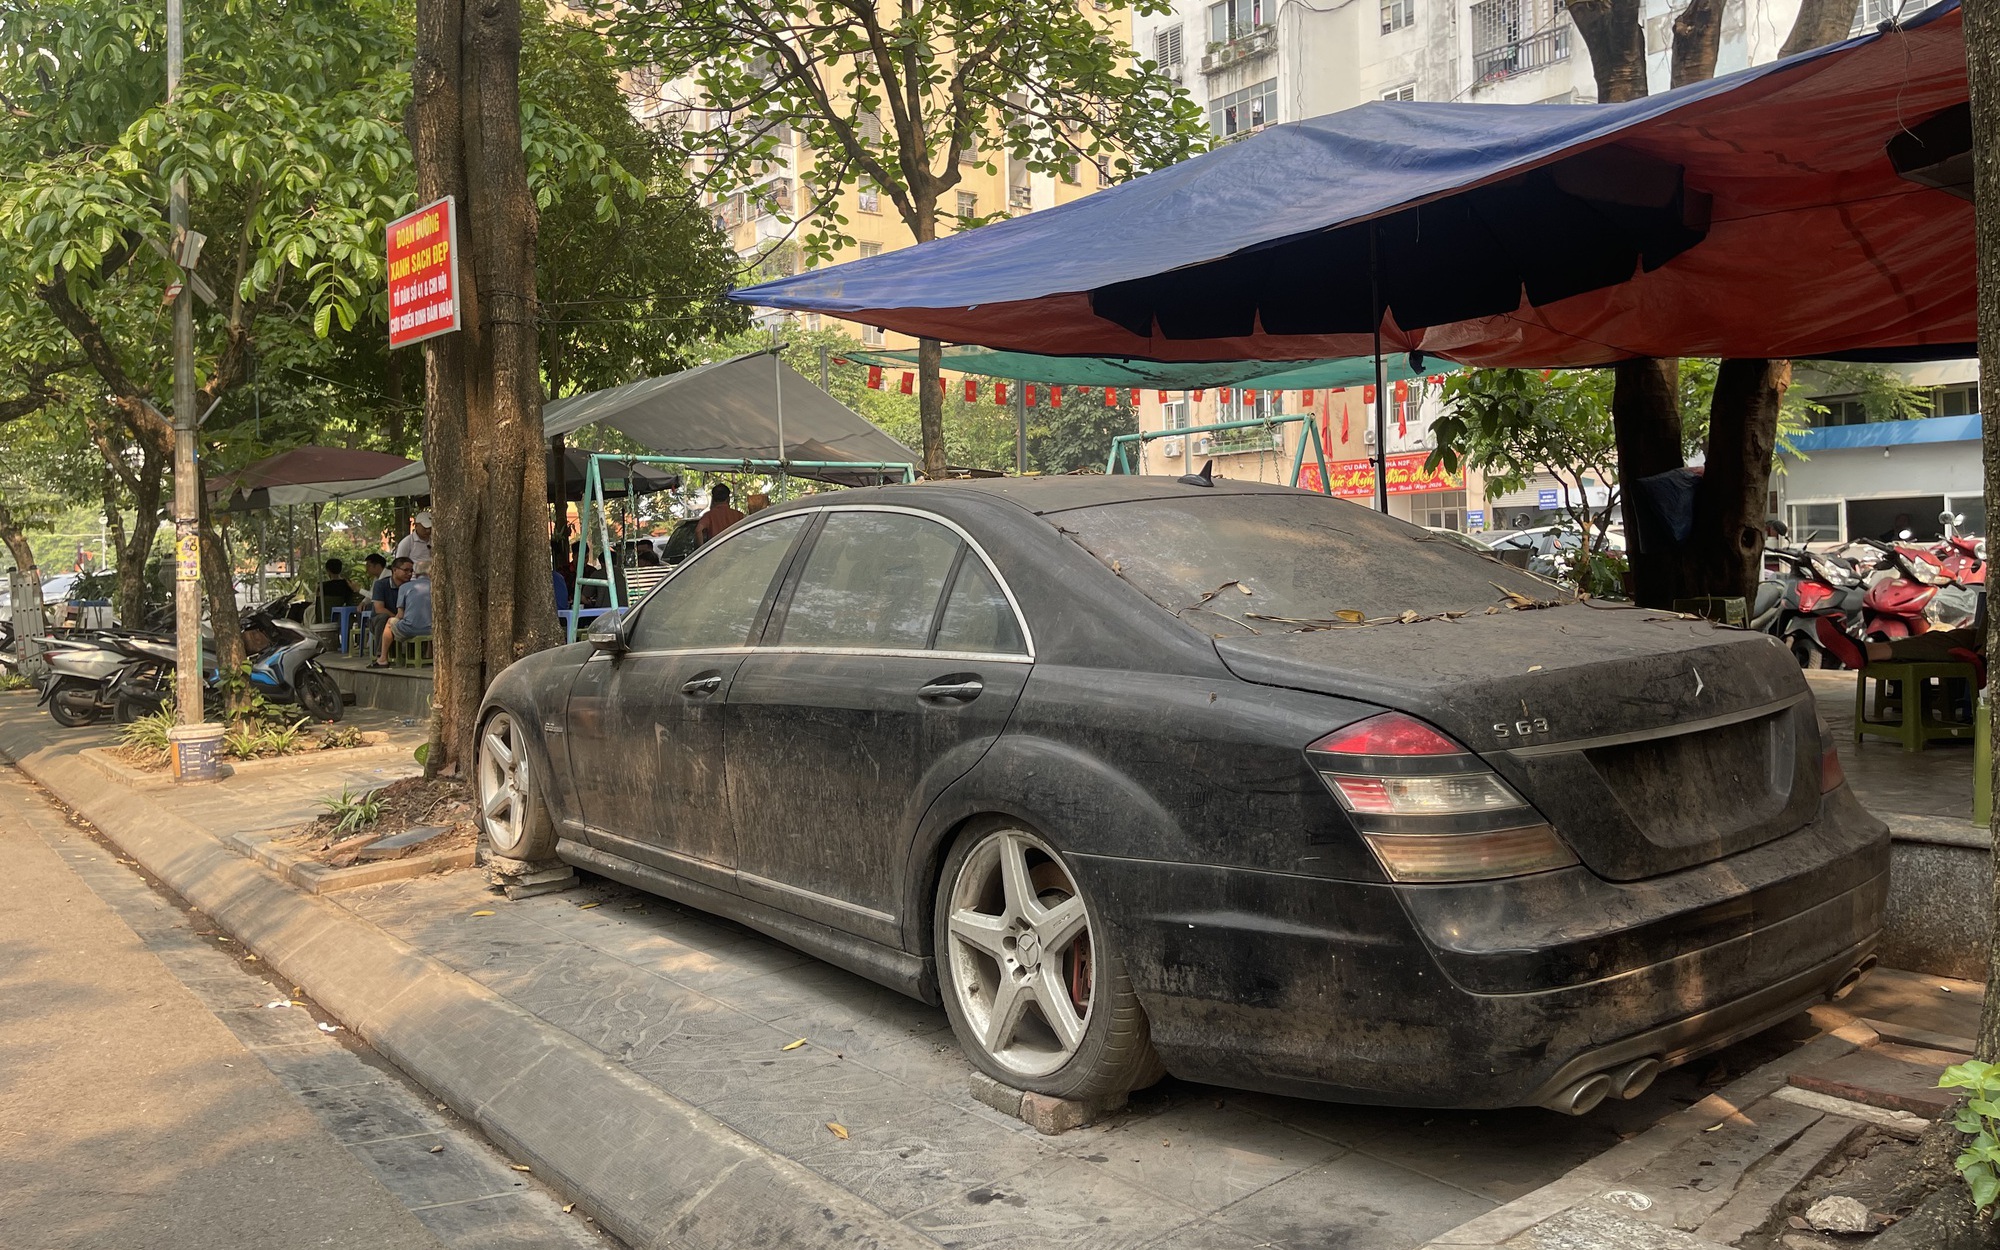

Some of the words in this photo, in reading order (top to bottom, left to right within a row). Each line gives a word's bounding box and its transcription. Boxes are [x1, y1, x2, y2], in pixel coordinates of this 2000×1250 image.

[396, 223, 415, 249] ĐOẠN
[415, 212, 440, 241] ĐƯỜNG
[390, 256, 410, 282] XANH
[411, 247, 432, 275] SẠCH
[432, 240, 449, 267] ĐẸP
[1493, 723, 1510, 738] S
[1515, 717, 1550, 736] 63
